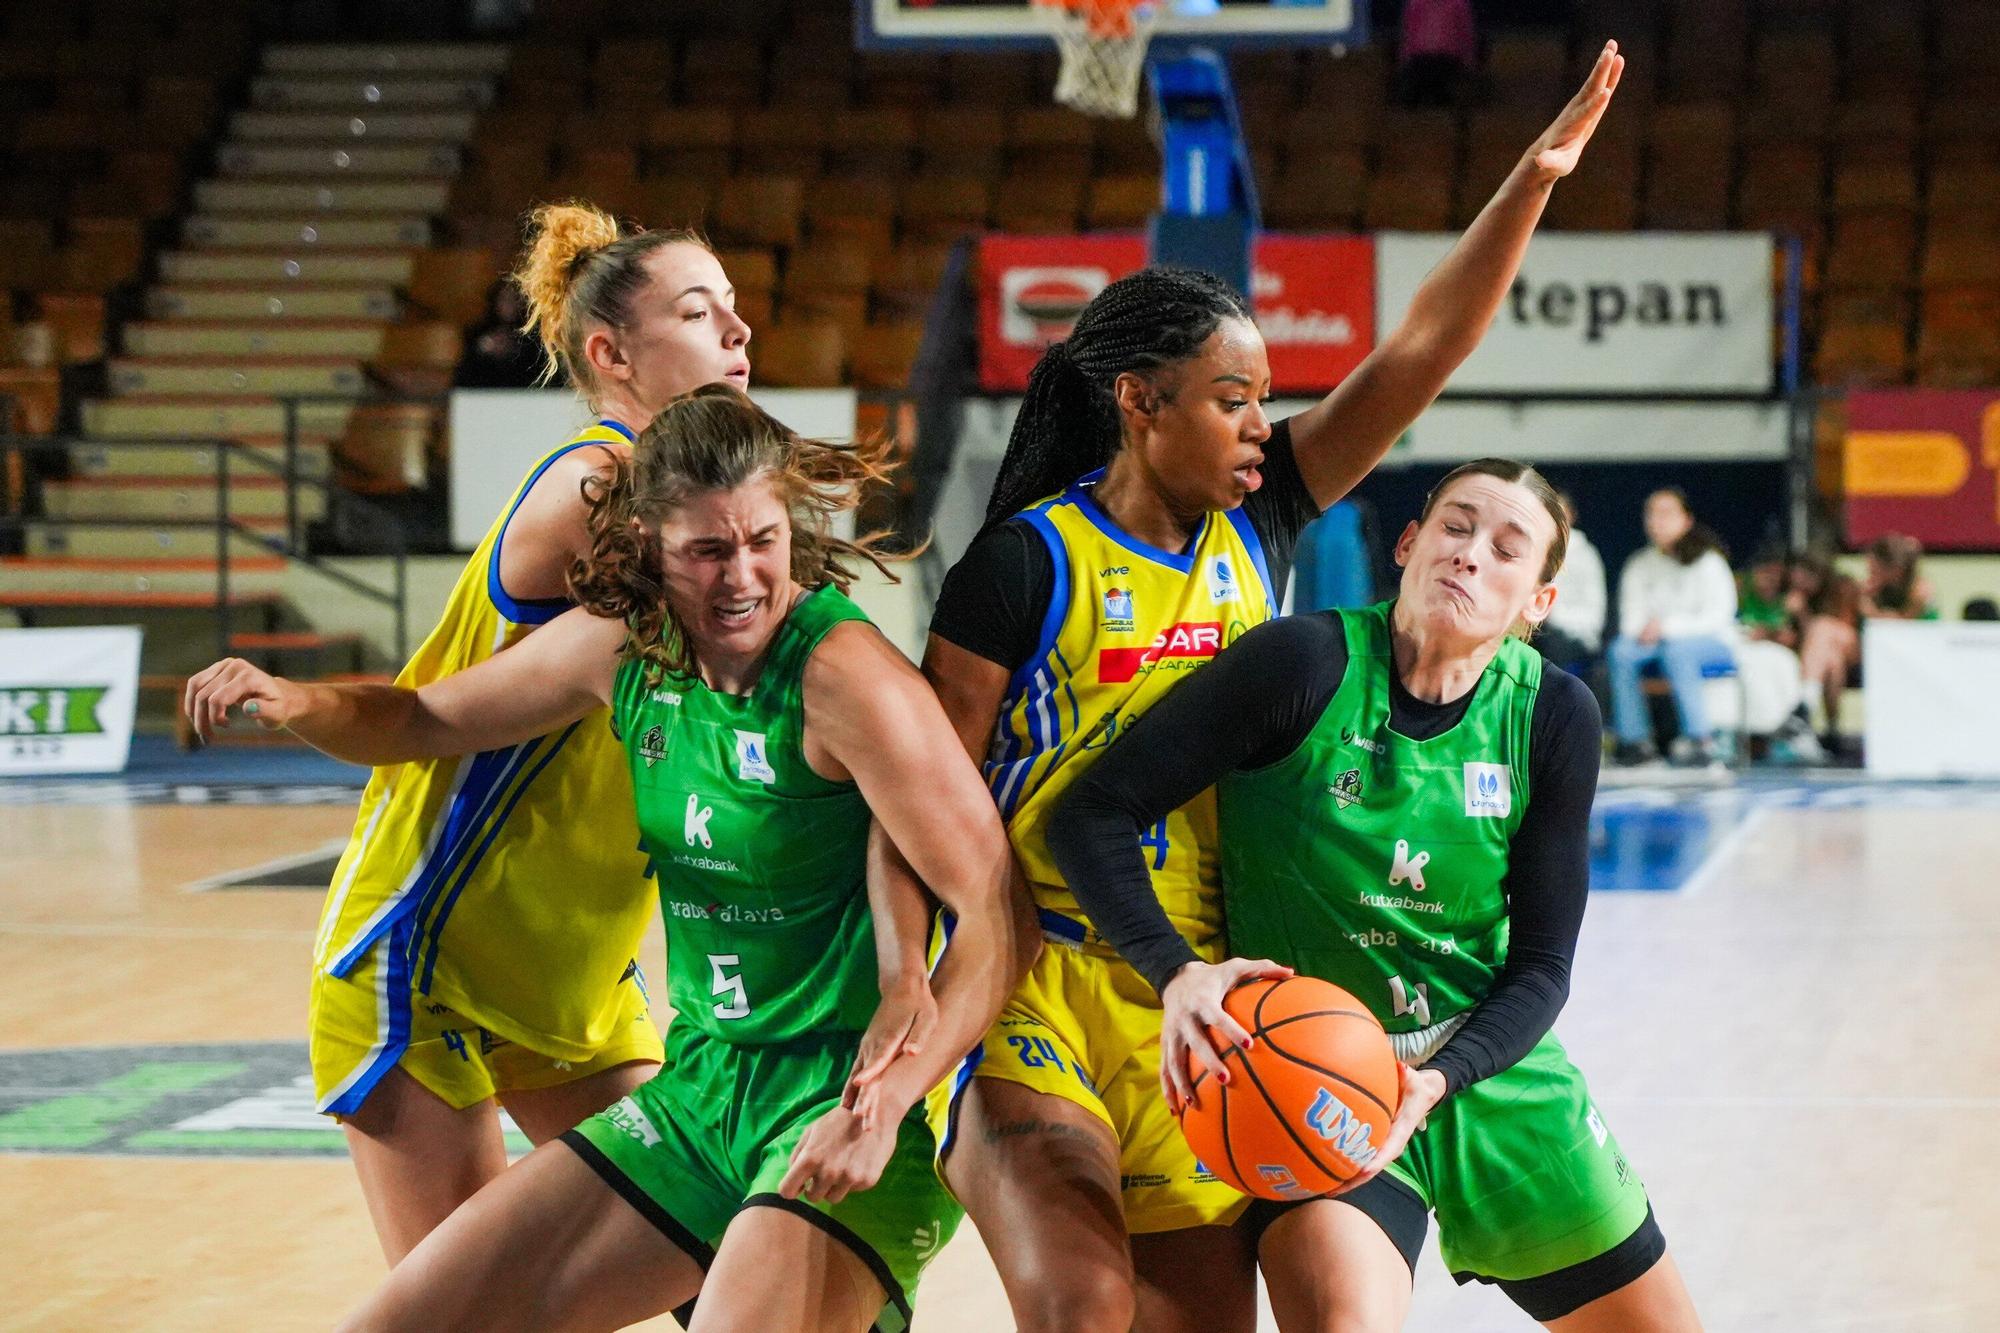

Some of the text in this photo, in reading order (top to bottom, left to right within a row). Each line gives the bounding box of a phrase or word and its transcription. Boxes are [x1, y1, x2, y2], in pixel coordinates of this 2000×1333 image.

[1360, 891, 1445, 914] kutxabank
[706, 953, 752, 1020] 5
[440, 1029, 470, 1062] 4
[1007, 1036, 1066, 1073] 24
